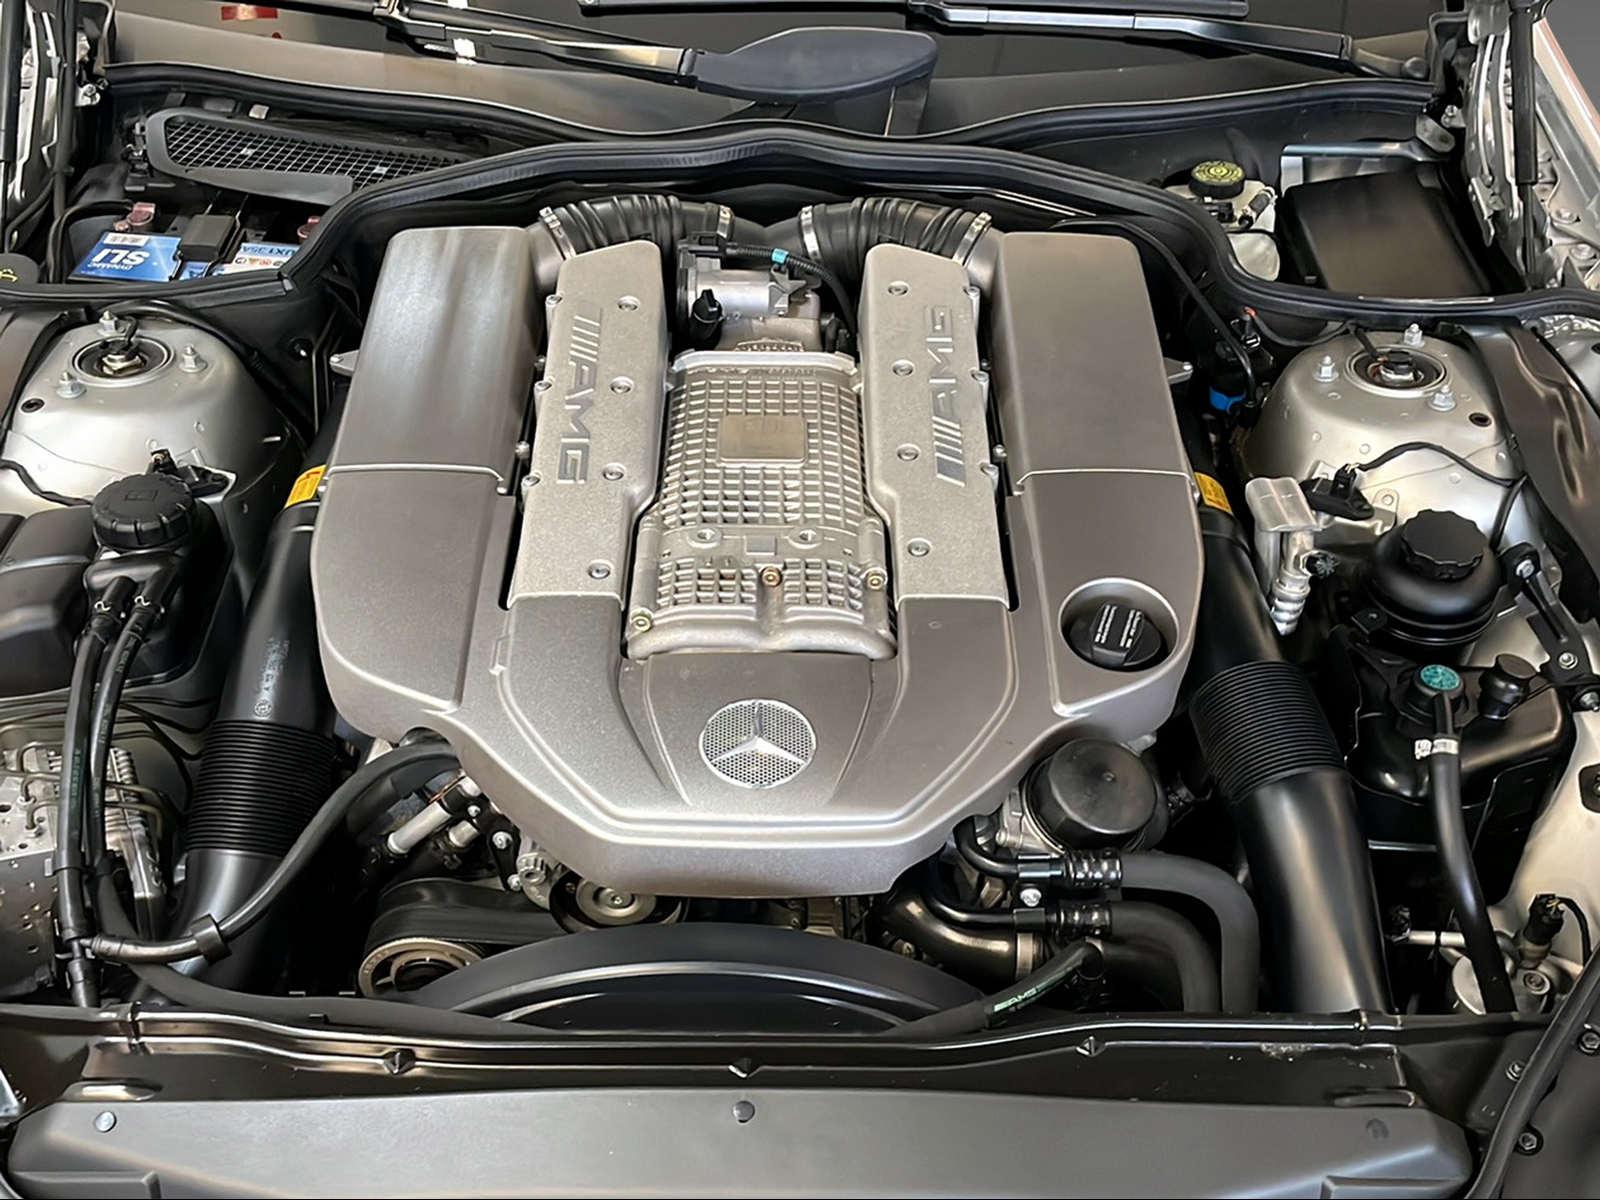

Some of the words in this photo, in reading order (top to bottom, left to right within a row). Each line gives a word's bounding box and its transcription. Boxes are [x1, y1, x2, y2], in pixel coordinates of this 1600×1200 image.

[92, 248, 150, 265] SLI
[555, 360, 598, 484] AMG
[924, 305, 961, 423] AMG
